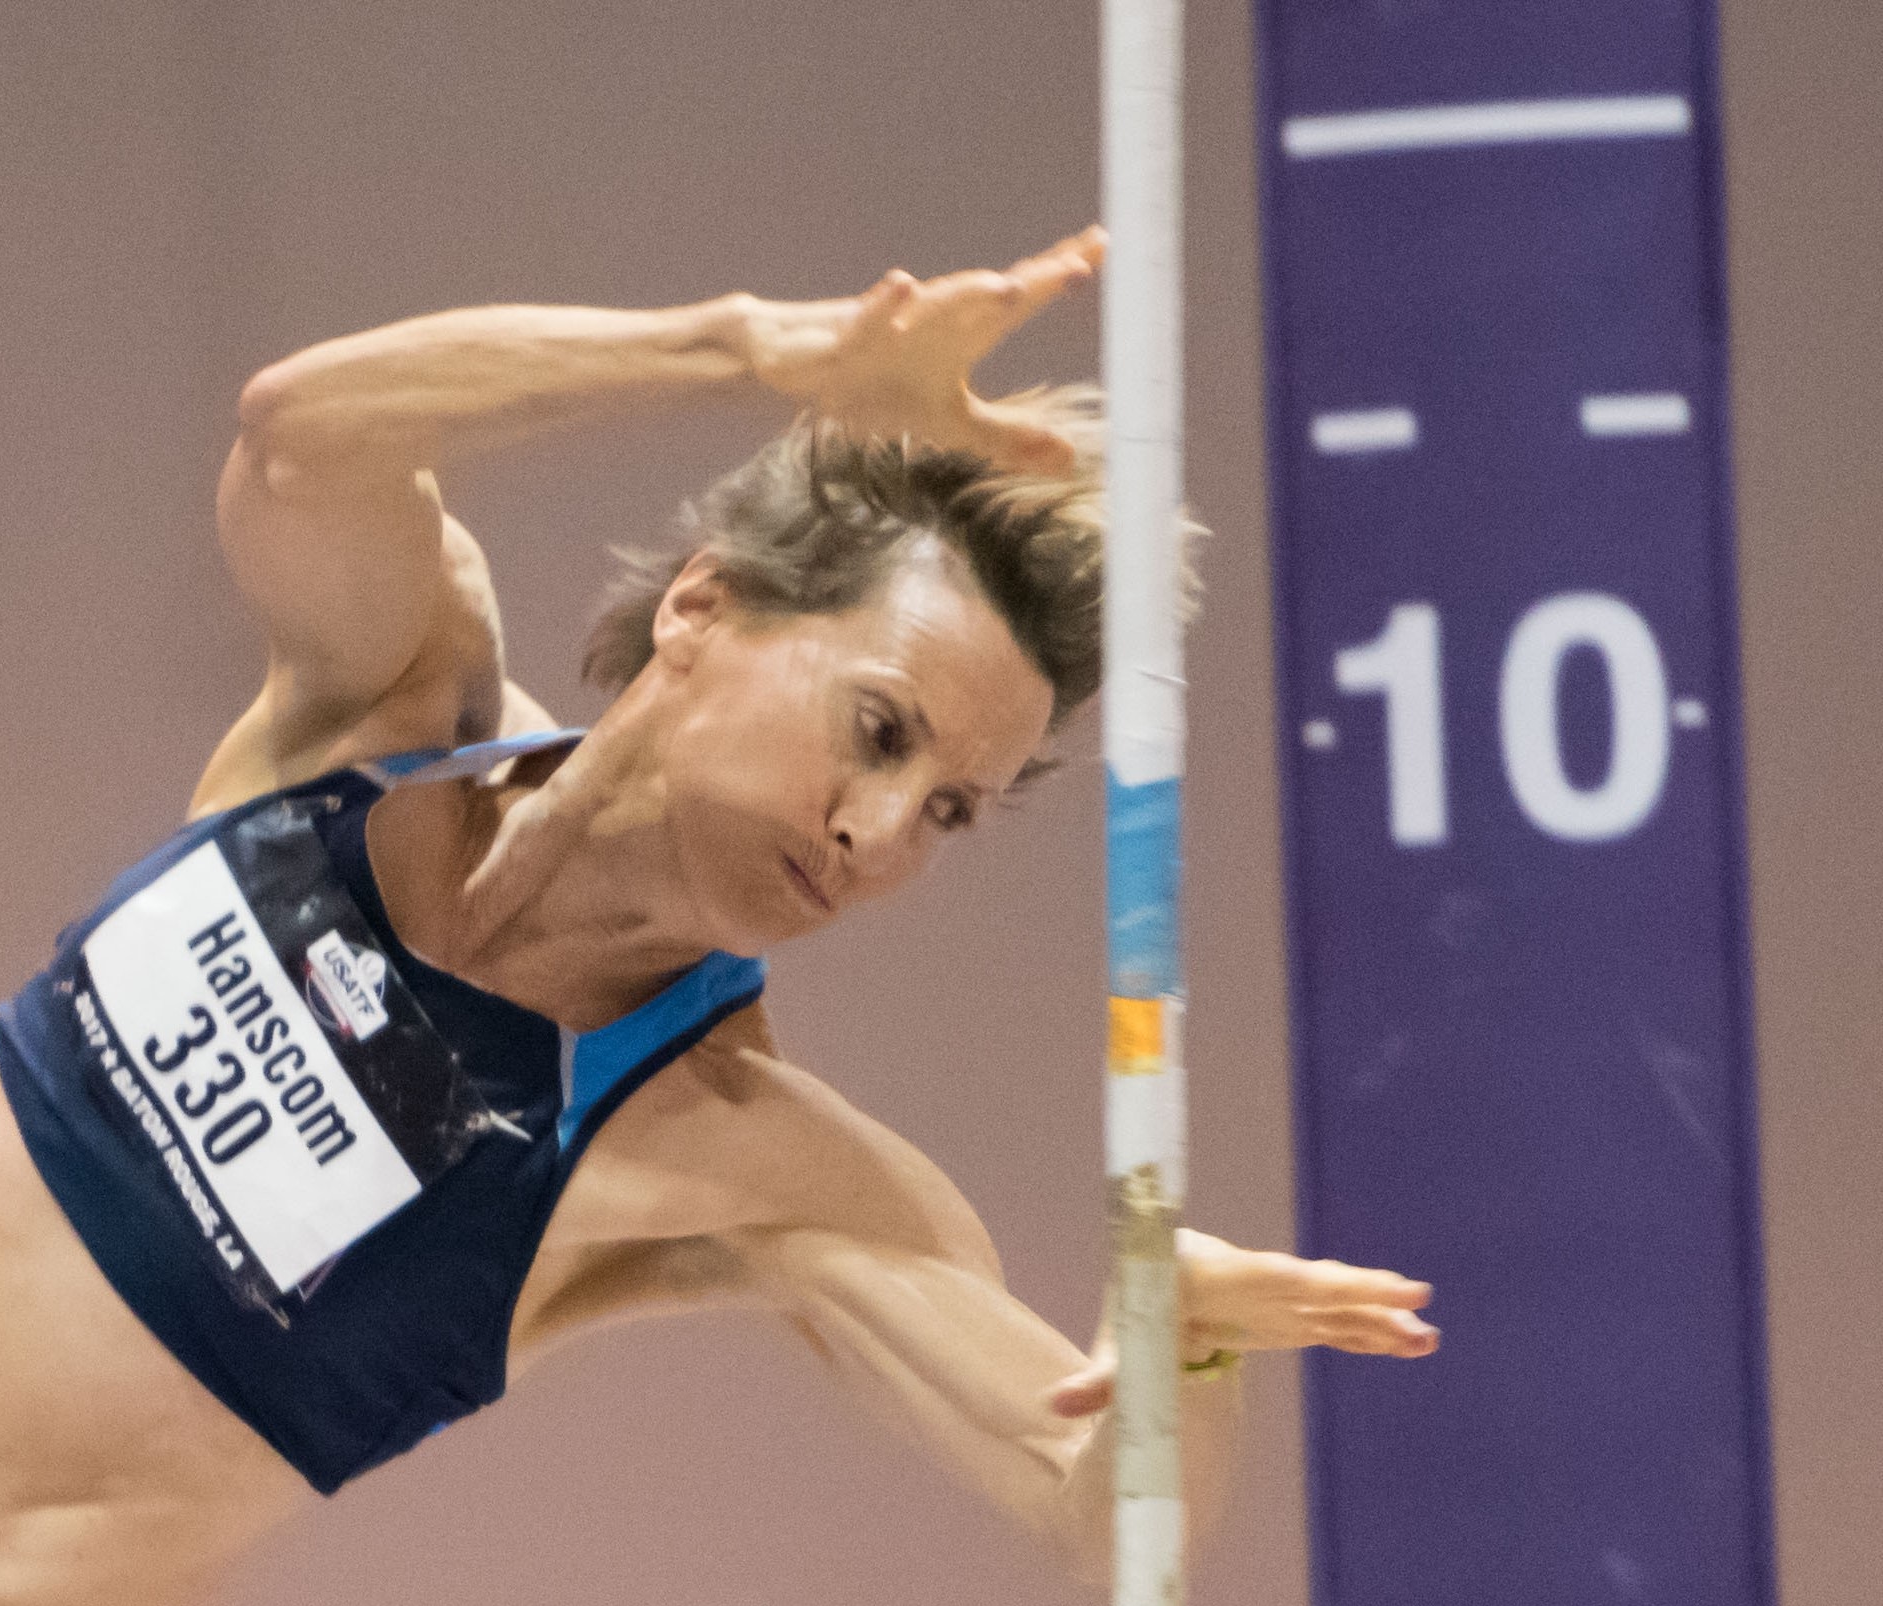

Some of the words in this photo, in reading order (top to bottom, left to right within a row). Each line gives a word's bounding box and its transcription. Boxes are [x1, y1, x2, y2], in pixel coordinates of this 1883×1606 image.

[1333, 591, 1672, 850] 10
[143, 1003, 273, 1166] 330
[187, 911, 357, 1167] Hanscom
[323, 946, 375, 1015] USATF
